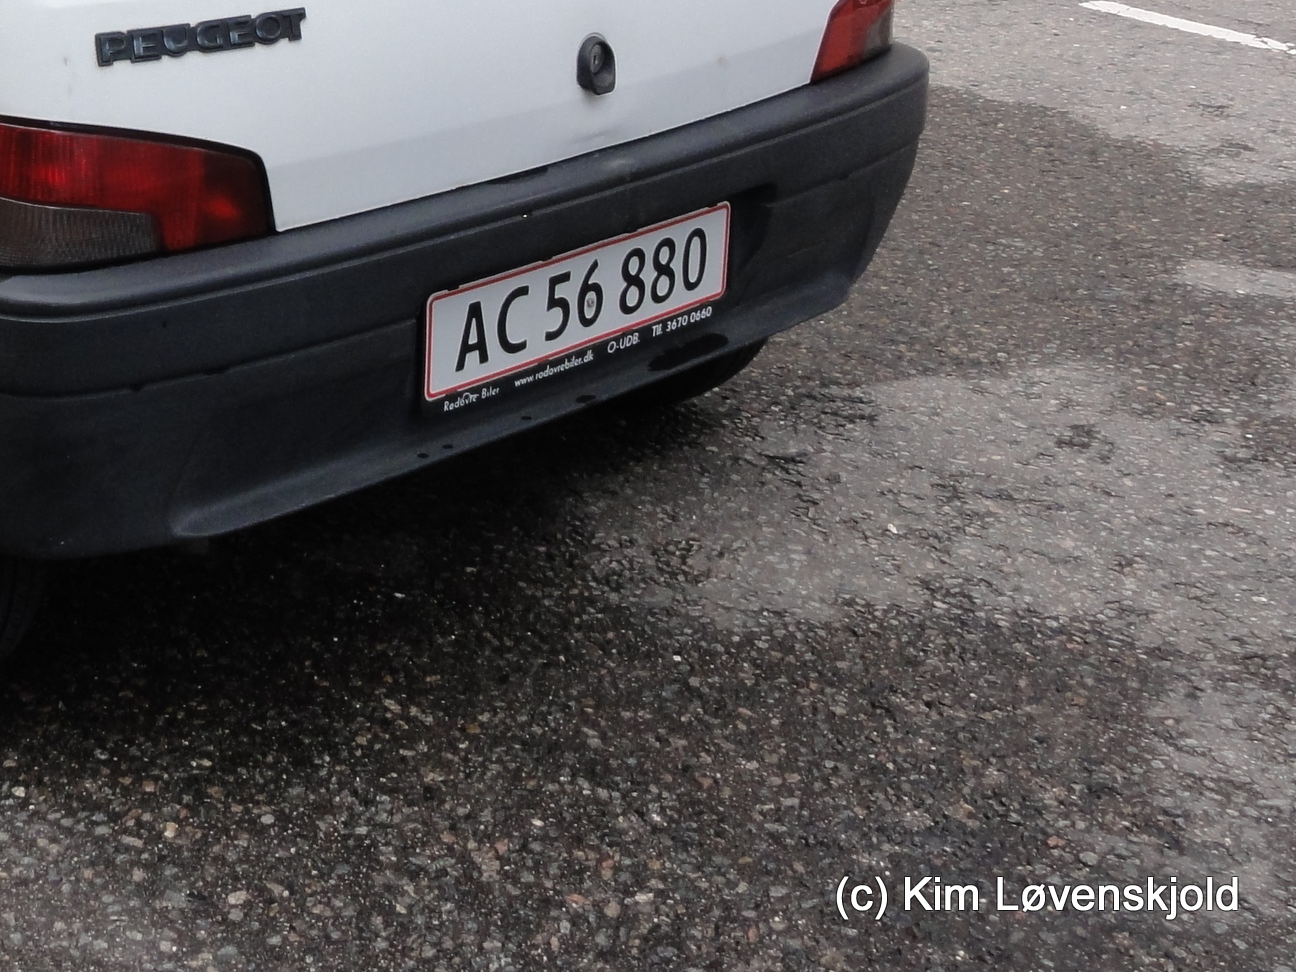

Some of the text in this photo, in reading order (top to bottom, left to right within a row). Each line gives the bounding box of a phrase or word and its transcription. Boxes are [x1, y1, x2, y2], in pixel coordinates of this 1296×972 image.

[95, 7, 307, 68] PEUGEOT
[455, 227, 708, 373] AC 56 880
[665, 314, 688, 332] 3670
[689, 306, 713, 323] 0660
